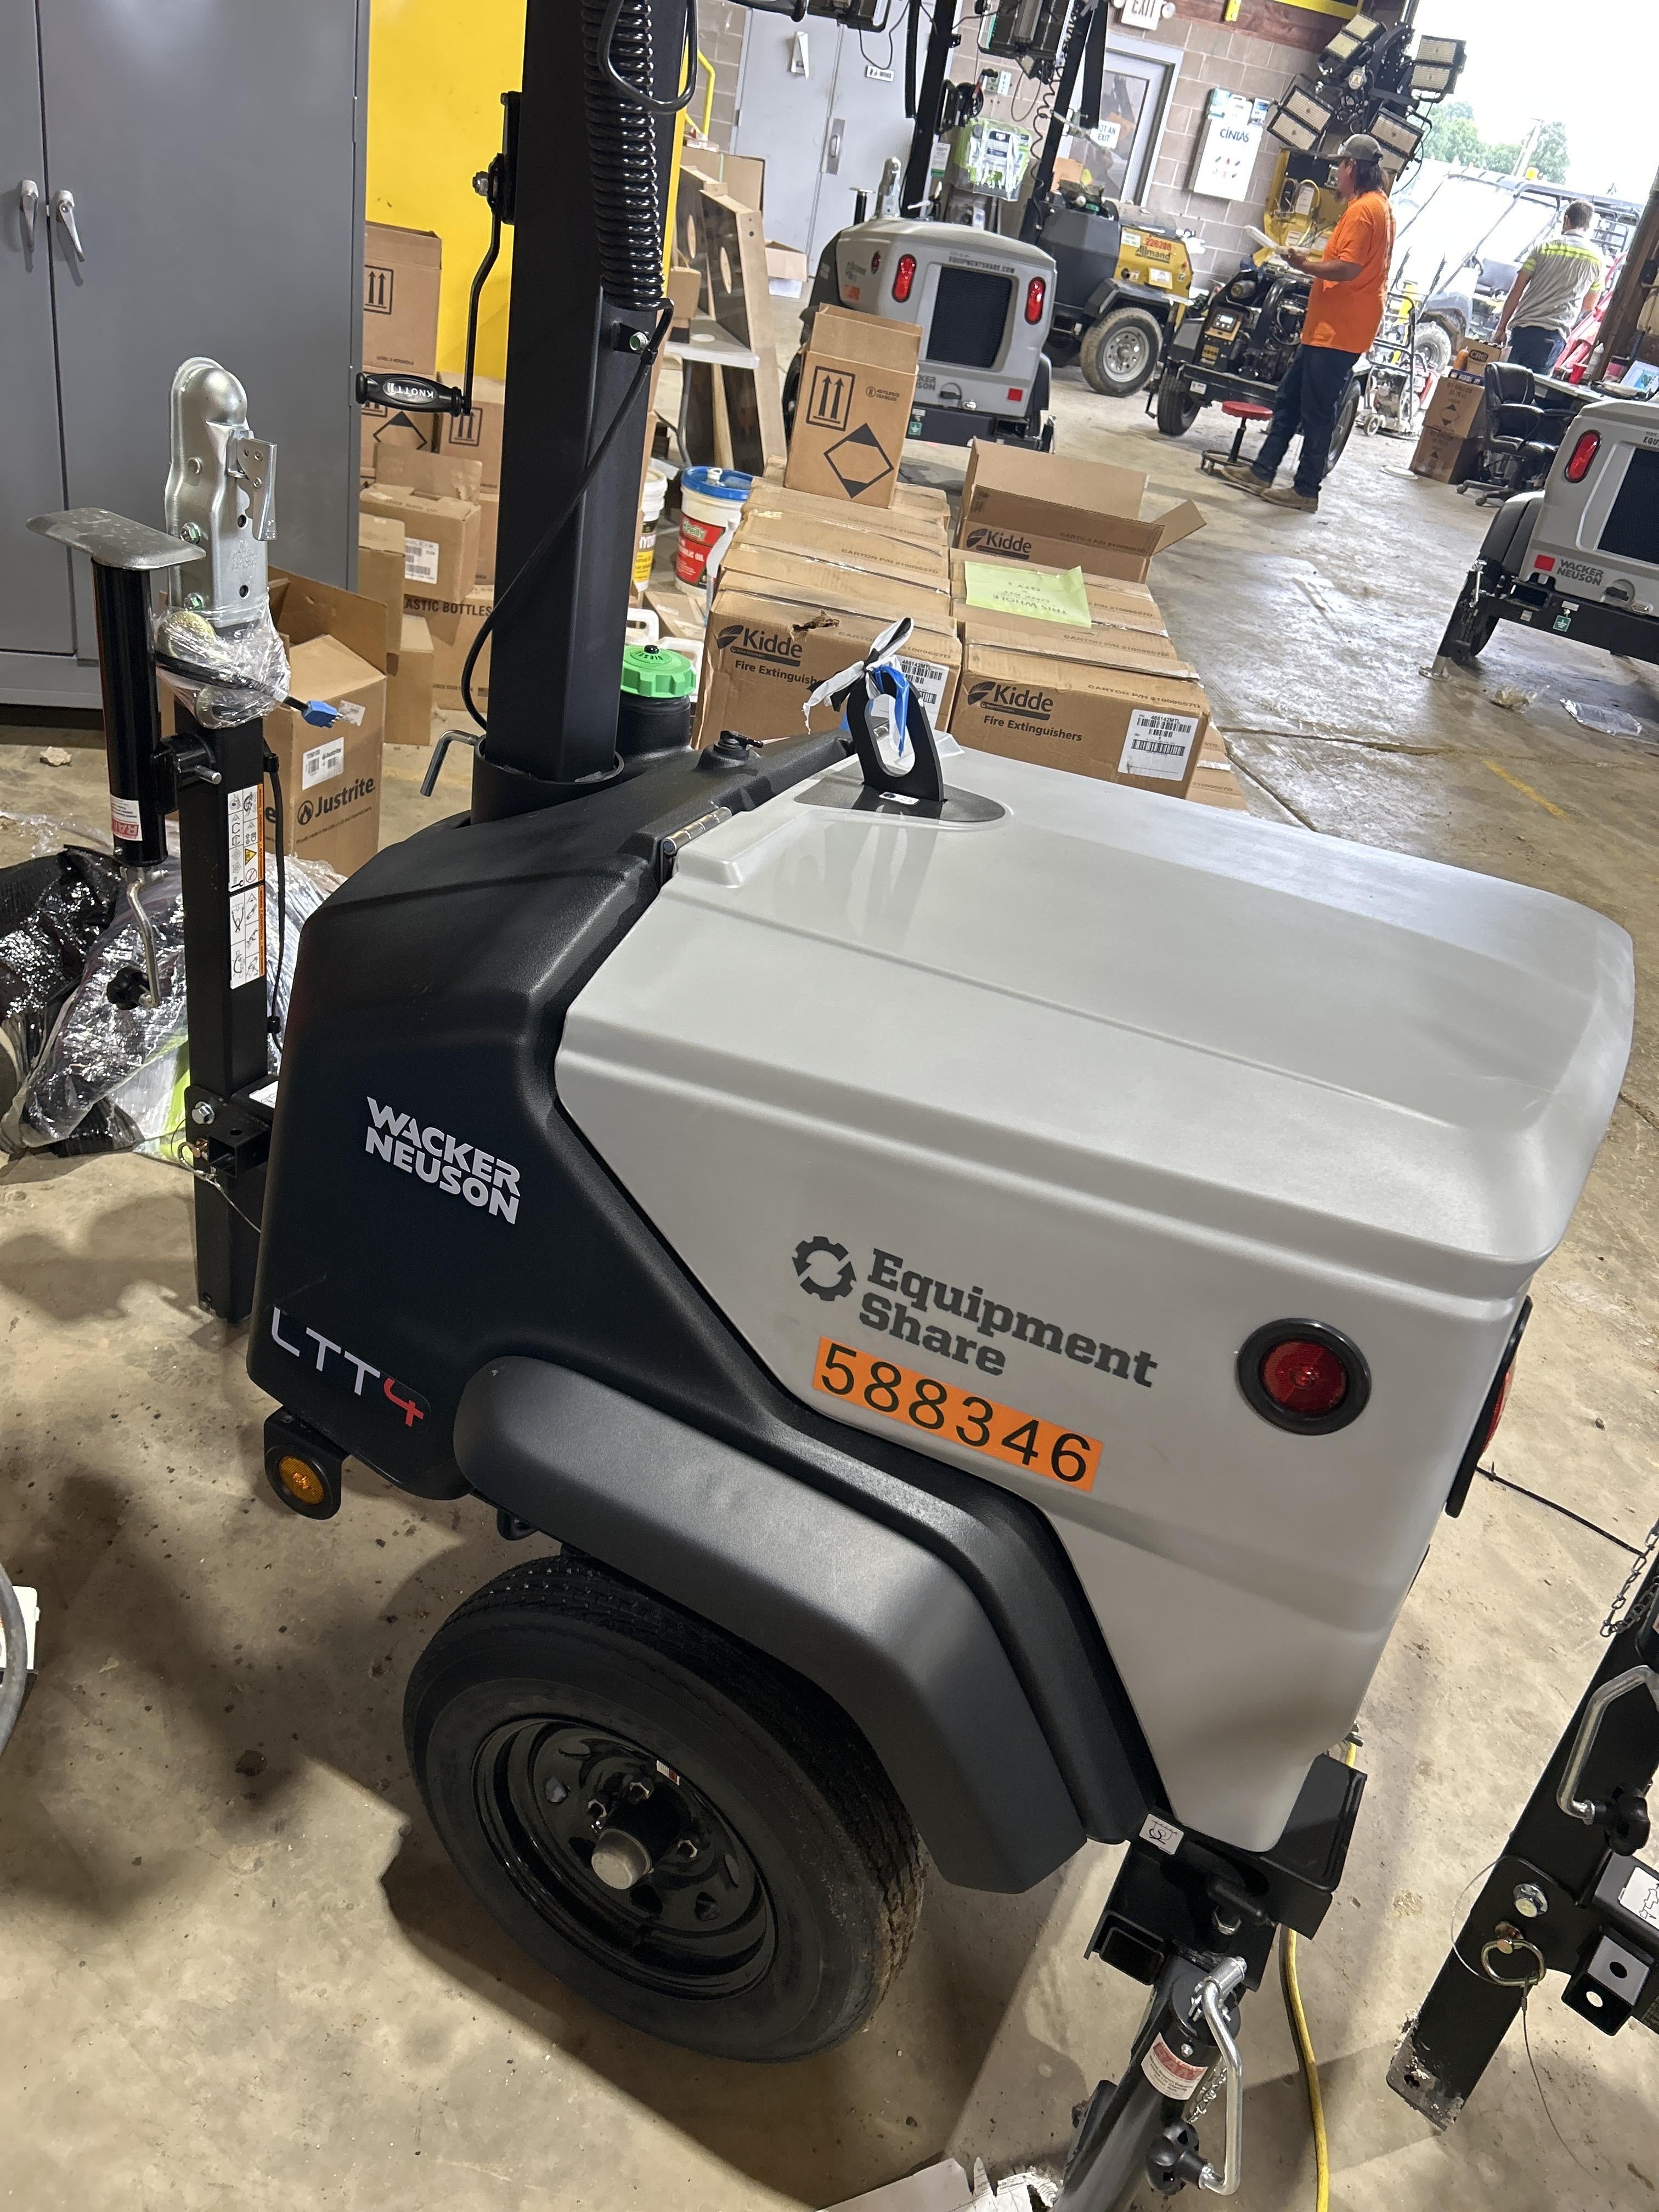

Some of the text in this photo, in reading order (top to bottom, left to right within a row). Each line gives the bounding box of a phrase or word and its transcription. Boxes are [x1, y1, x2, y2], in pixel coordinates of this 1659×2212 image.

[1131, 0, 1158, 18] EXIT
[1098, 133, 1110, 142] EXIT
[398, 386, 434, 398] KNOTT
[986, 531, 1032, 554] Kidde
[841, 549, 878, 560] CARTON
[1556, 567, 1601, 586] NEUSON
[1560, 559, 1604, 578] WACKER
[443, 600, 493, 617] BOTTLES
[991, 593, 1068, 615] THIS WHOLE
[743, 628, 803, 658] Kidde
[838, 631, 872, 642] CARTO
[1064, 634, 1102, 645] CARTON
[635, 651, 663, 661] DIESEL
[735, 659, 821, 685] Fire Extinguish
[994, 684, 1053, 712] Kidde
[1088, 685, 1129, 696] CARTON
[983, 715, 1083, 742] Fire Extinguishers
[315, 777, 375, 818] Justrite
[366, 1096, 521, 1197] WACKER
[365, 1126, 519, 1224] NEUSON
[867, 1248, 1158, 1388] Equipment
[859, 1292, 1006, 1376] Share
[272, 1307, 424, 1427] LTT4
[821, 1342, 1092, 1482] 588346
